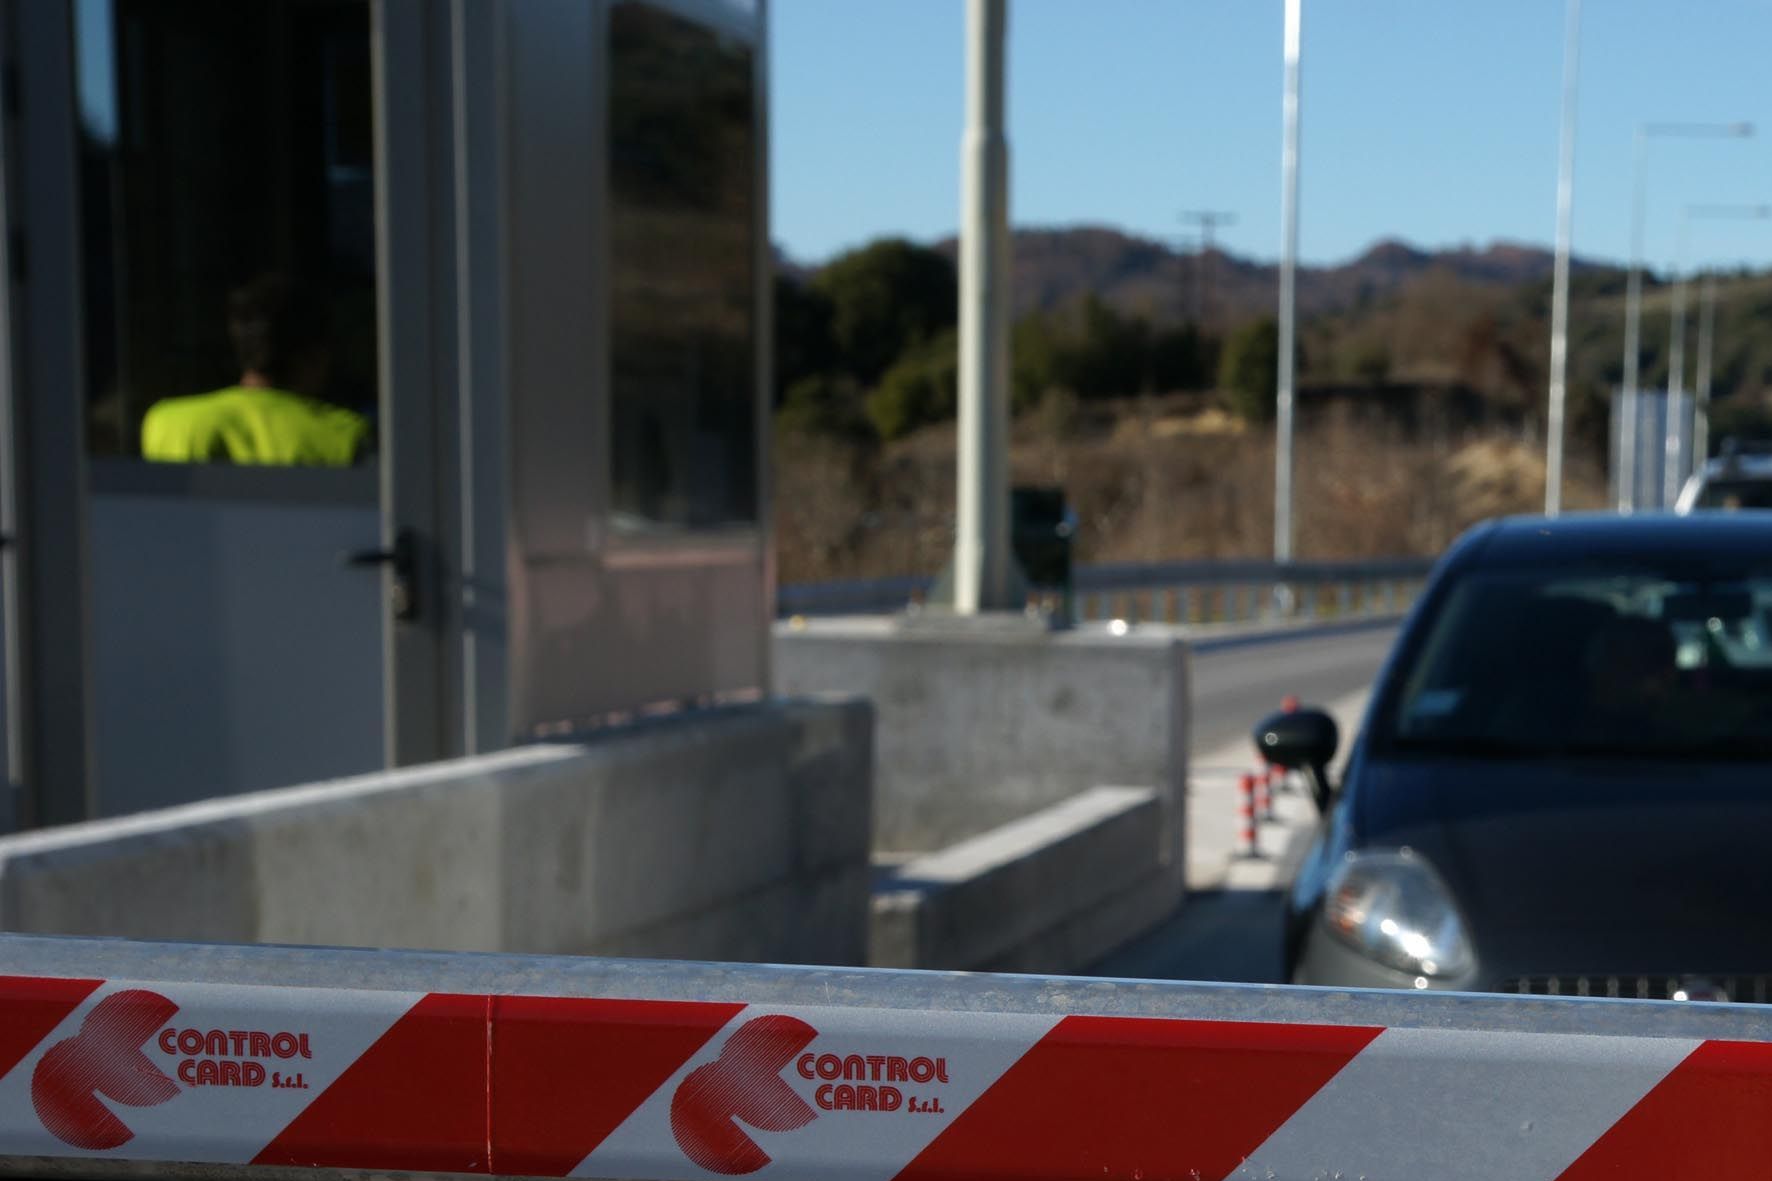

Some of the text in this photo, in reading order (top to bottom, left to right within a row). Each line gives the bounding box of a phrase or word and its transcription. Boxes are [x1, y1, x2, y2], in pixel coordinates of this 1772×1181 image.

[158, 1028, 312, 1059] CONTROL
[177, 1059, 266, 1087] CARD
[796, 1053, 949, 1083] CONTROL
[815, 1084, 902, 1112] CARD
